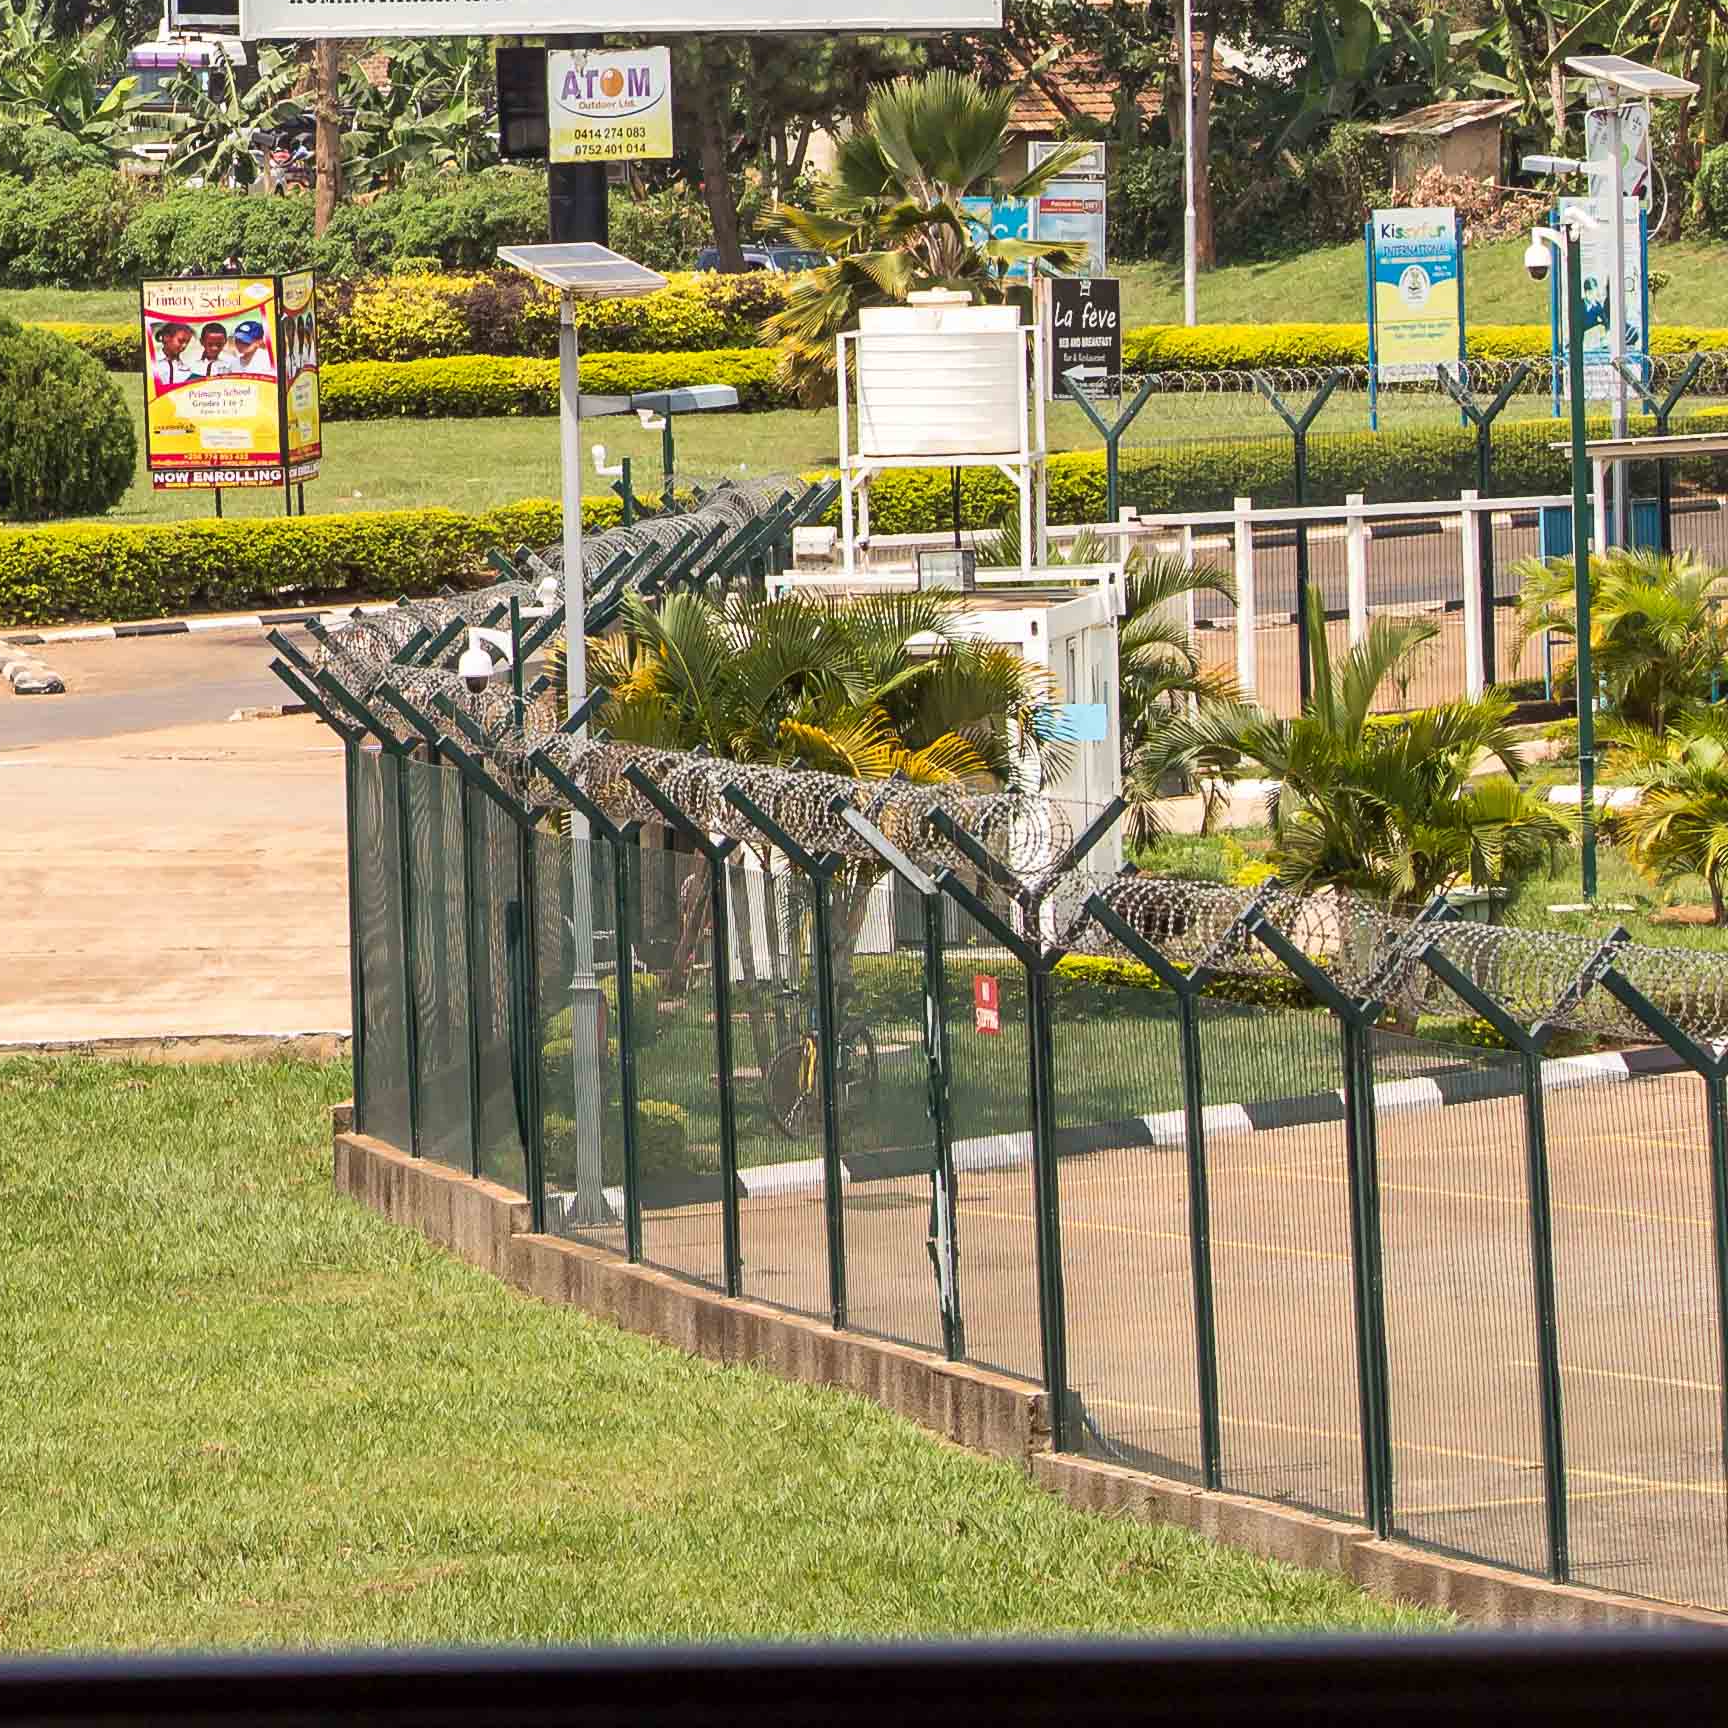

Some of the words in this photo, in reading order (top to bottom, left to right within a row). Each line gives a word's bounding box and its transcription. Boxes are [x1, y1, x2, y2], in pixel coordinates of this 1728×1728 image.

[575, 128, 602, 140] 0414
[604, 128, 624, 139] 274
[626, 127, 647, 139] 083
[604, 144, 624, 155] 401
[626, 143, 647, 154] 014
[1055, 302, 1072, 328] La
[154, 472, 189, 484] NOW
[193, 470, 281, 482] ENROLLING
